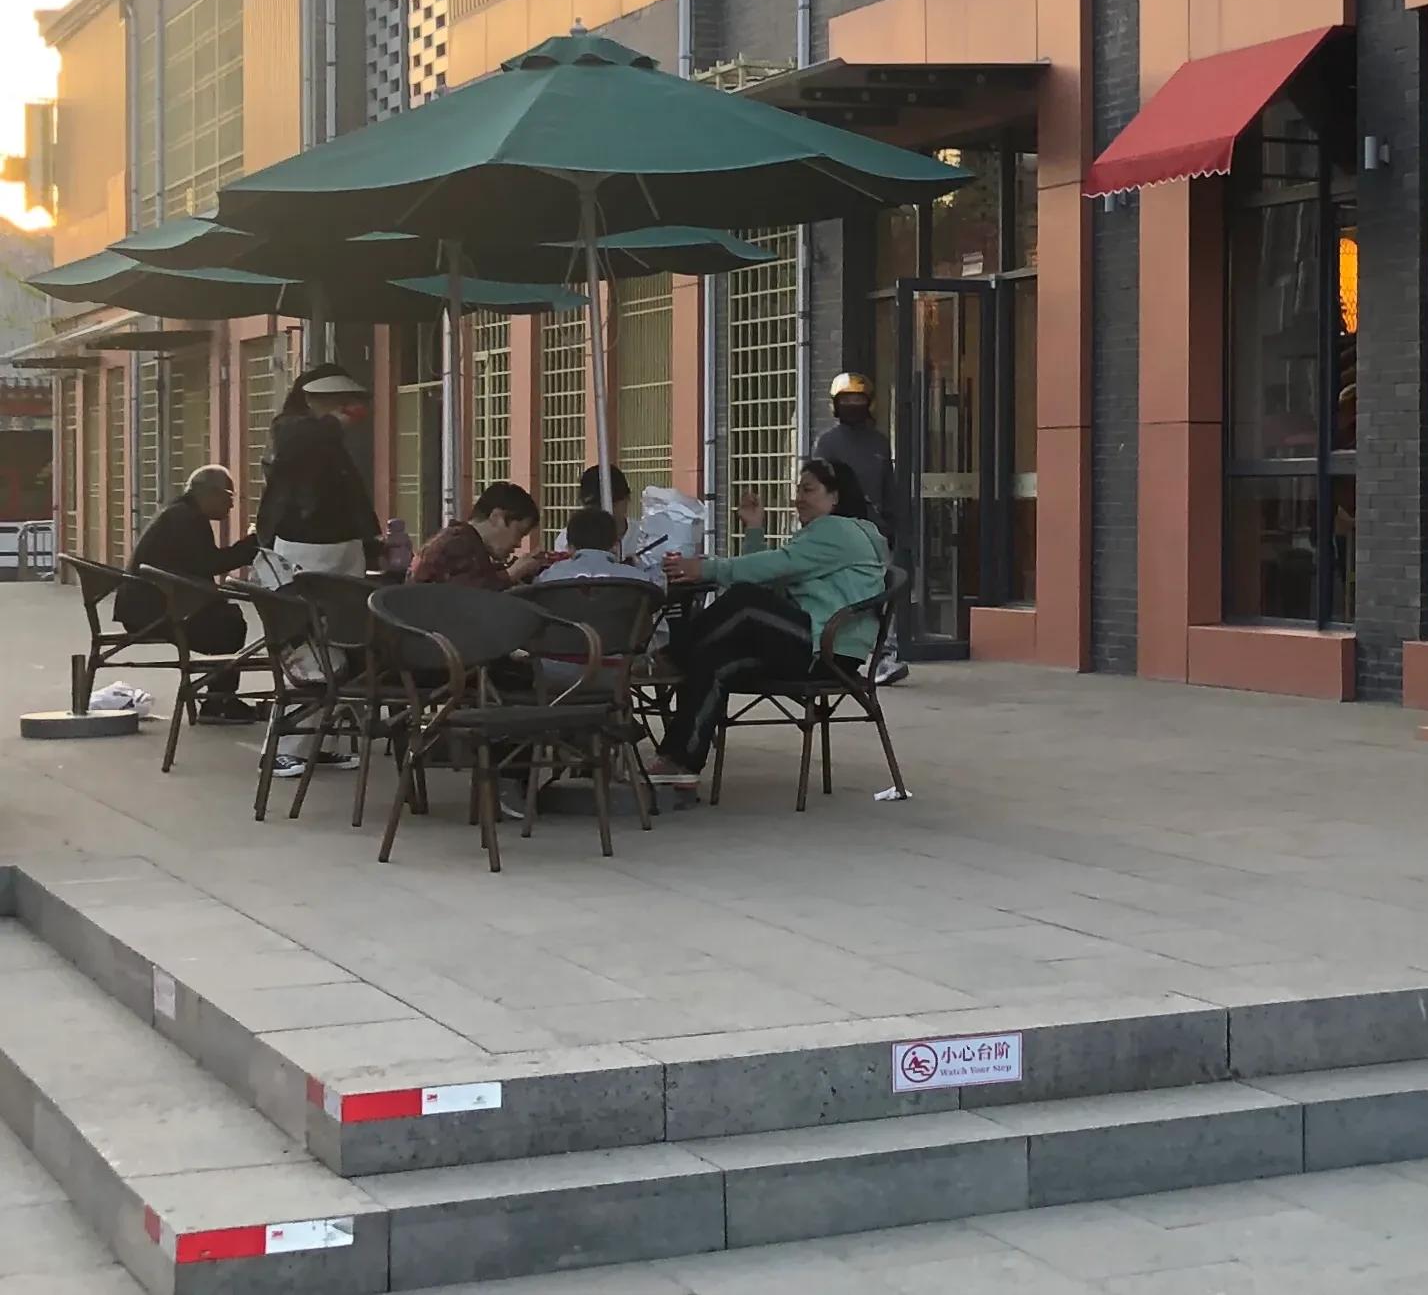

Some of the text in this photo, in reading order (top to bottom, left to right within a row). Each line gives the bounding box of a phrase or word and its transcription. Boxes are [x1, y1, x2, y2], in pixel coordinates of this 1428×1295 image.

[941, 1041, 1011, 1064] 小心台阶
[940, 1064, 1012, 1077] Watch Your Step
